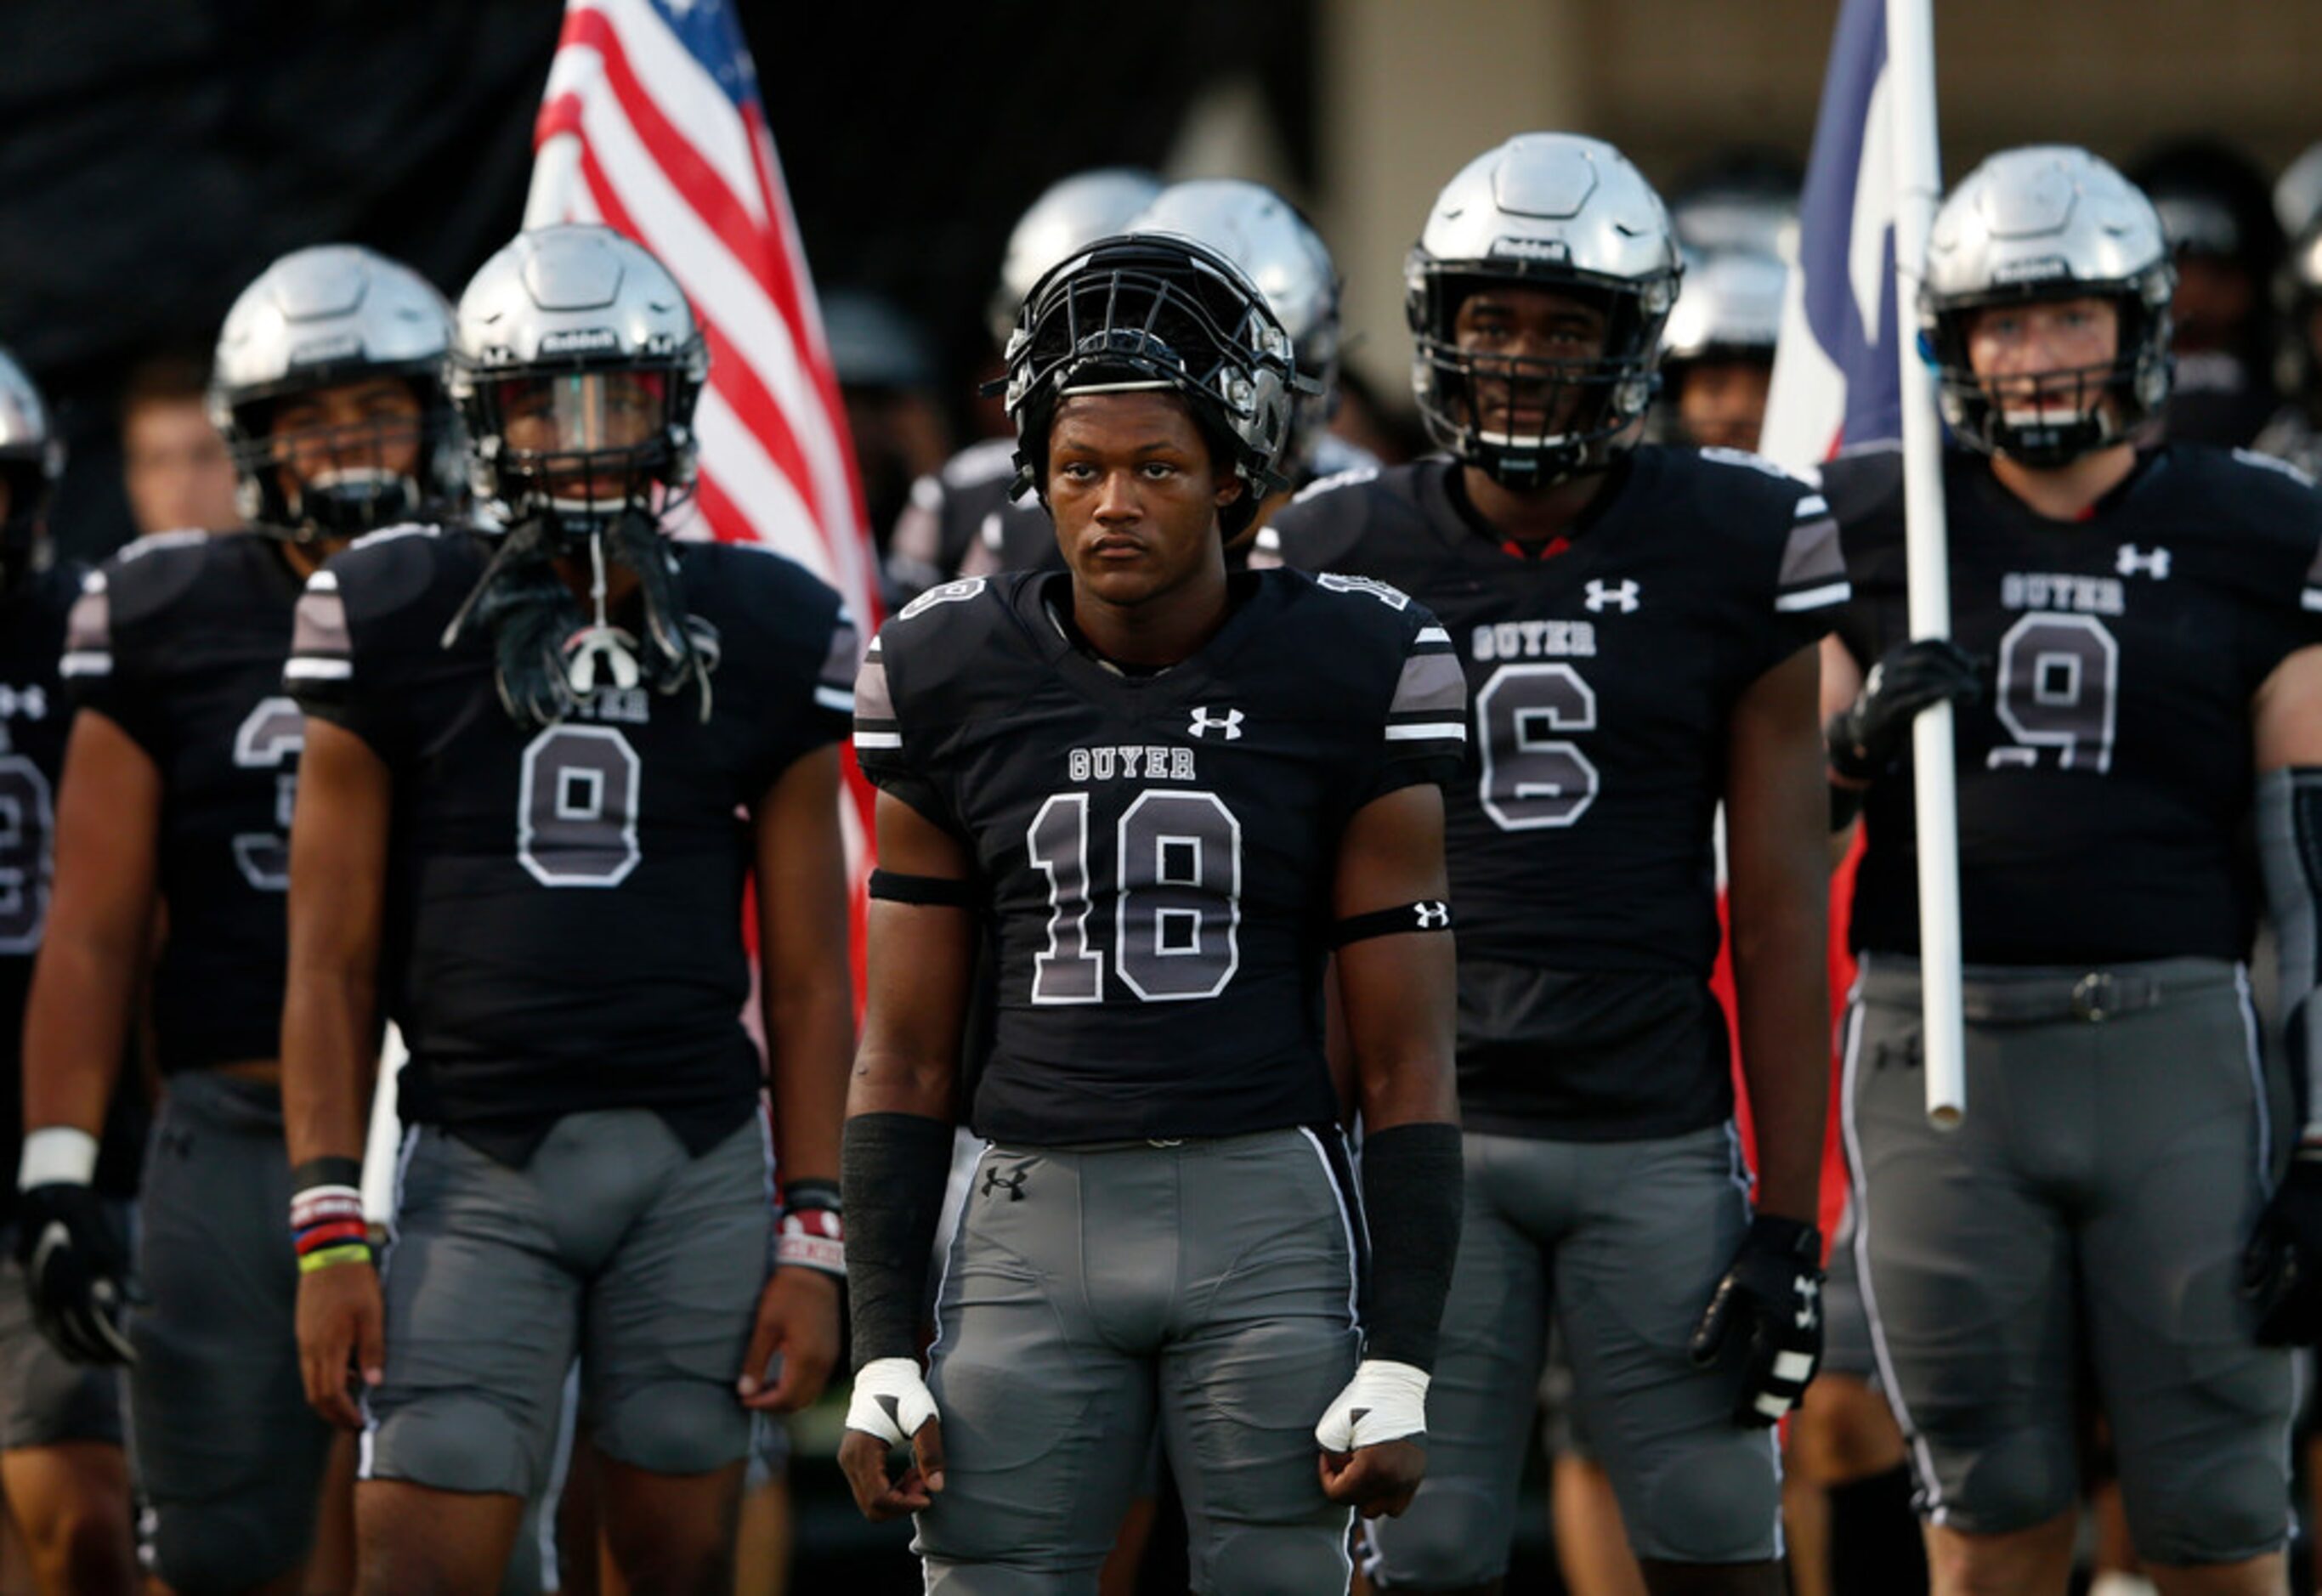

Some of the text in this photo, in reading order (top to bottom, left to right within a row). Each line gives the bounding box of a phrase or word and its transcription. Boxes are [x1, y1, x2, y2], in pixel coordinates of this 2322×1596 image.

[1472, 620, 1597, 661] GUYER
[2001, 573, 2125, 616] GUYER
[1987, 611, 2119, 774] 9
[1068, 745, 1197, 781] GUYER
[1475, 662, 1600, 831] 6
[1026, 788, 1243, 1006] 18
